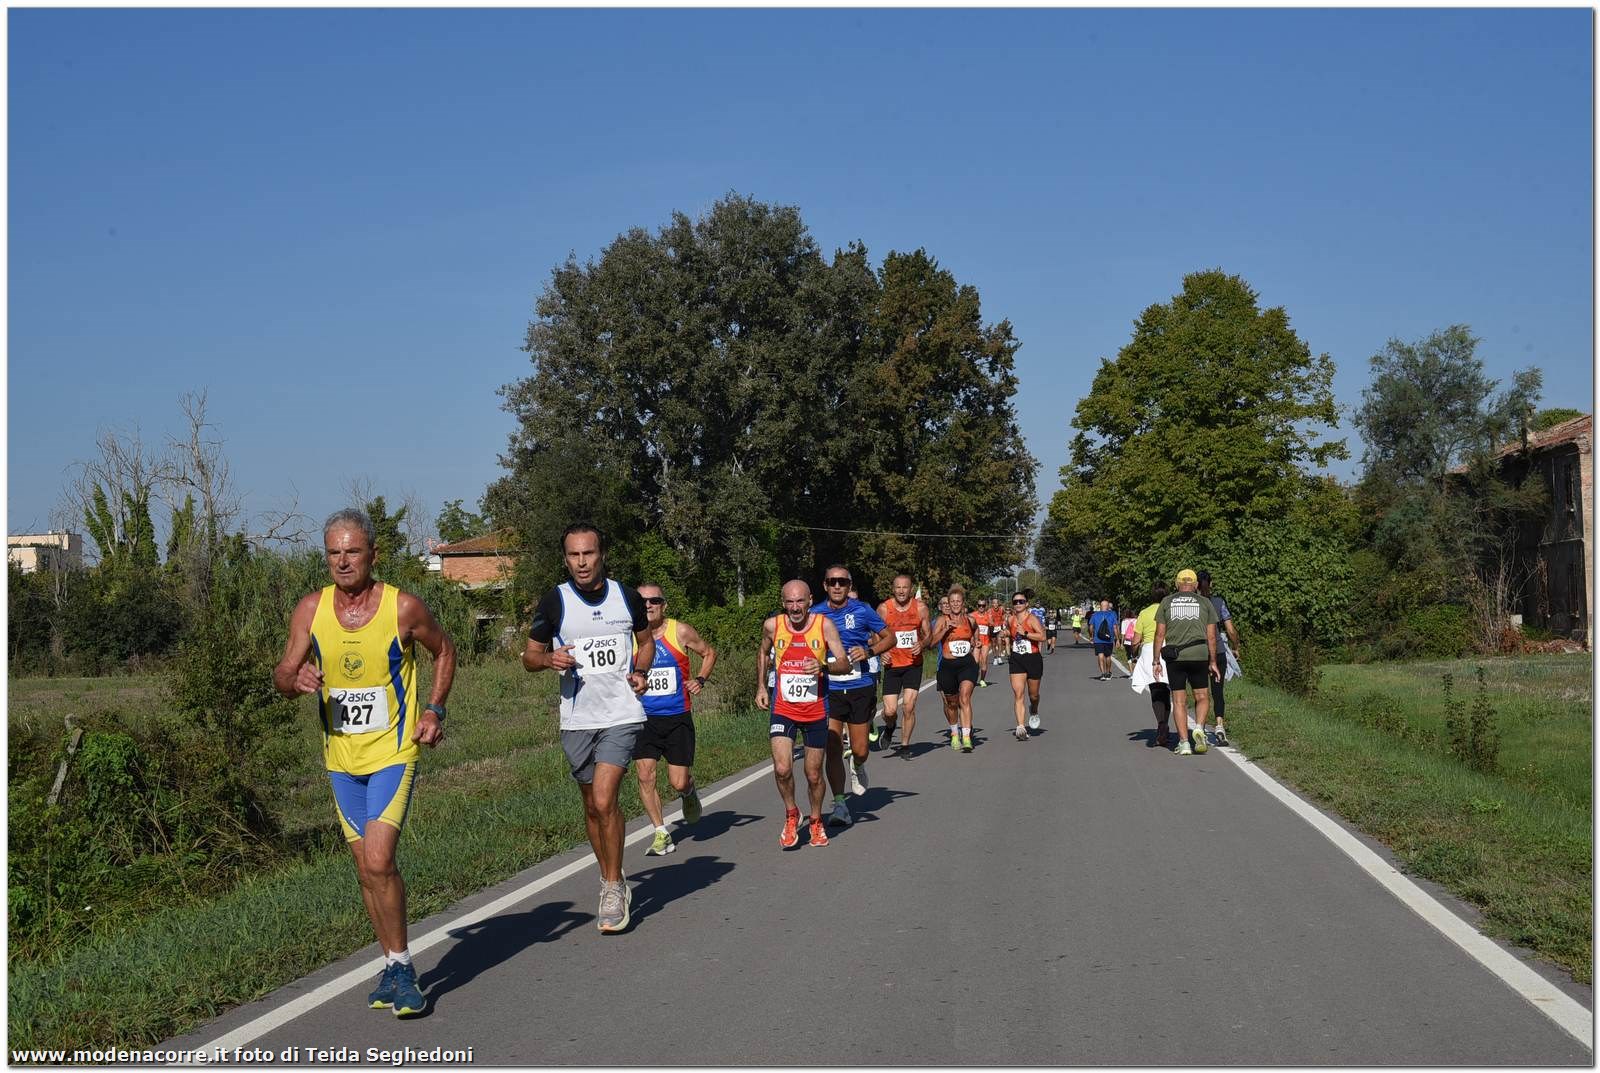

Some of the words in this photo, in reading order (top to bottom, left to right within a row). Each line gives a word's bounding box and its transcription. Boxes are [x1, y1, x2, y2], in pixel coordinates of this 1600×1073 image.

[594, 638, 617, 648] asics
[588, 649, 616, 668] 180
[648, 678, 669, 691] 488
[788, 684, 810, 698] 497
[347, 691, 376, 702] asics
[341, 704, 373, 725] 427
